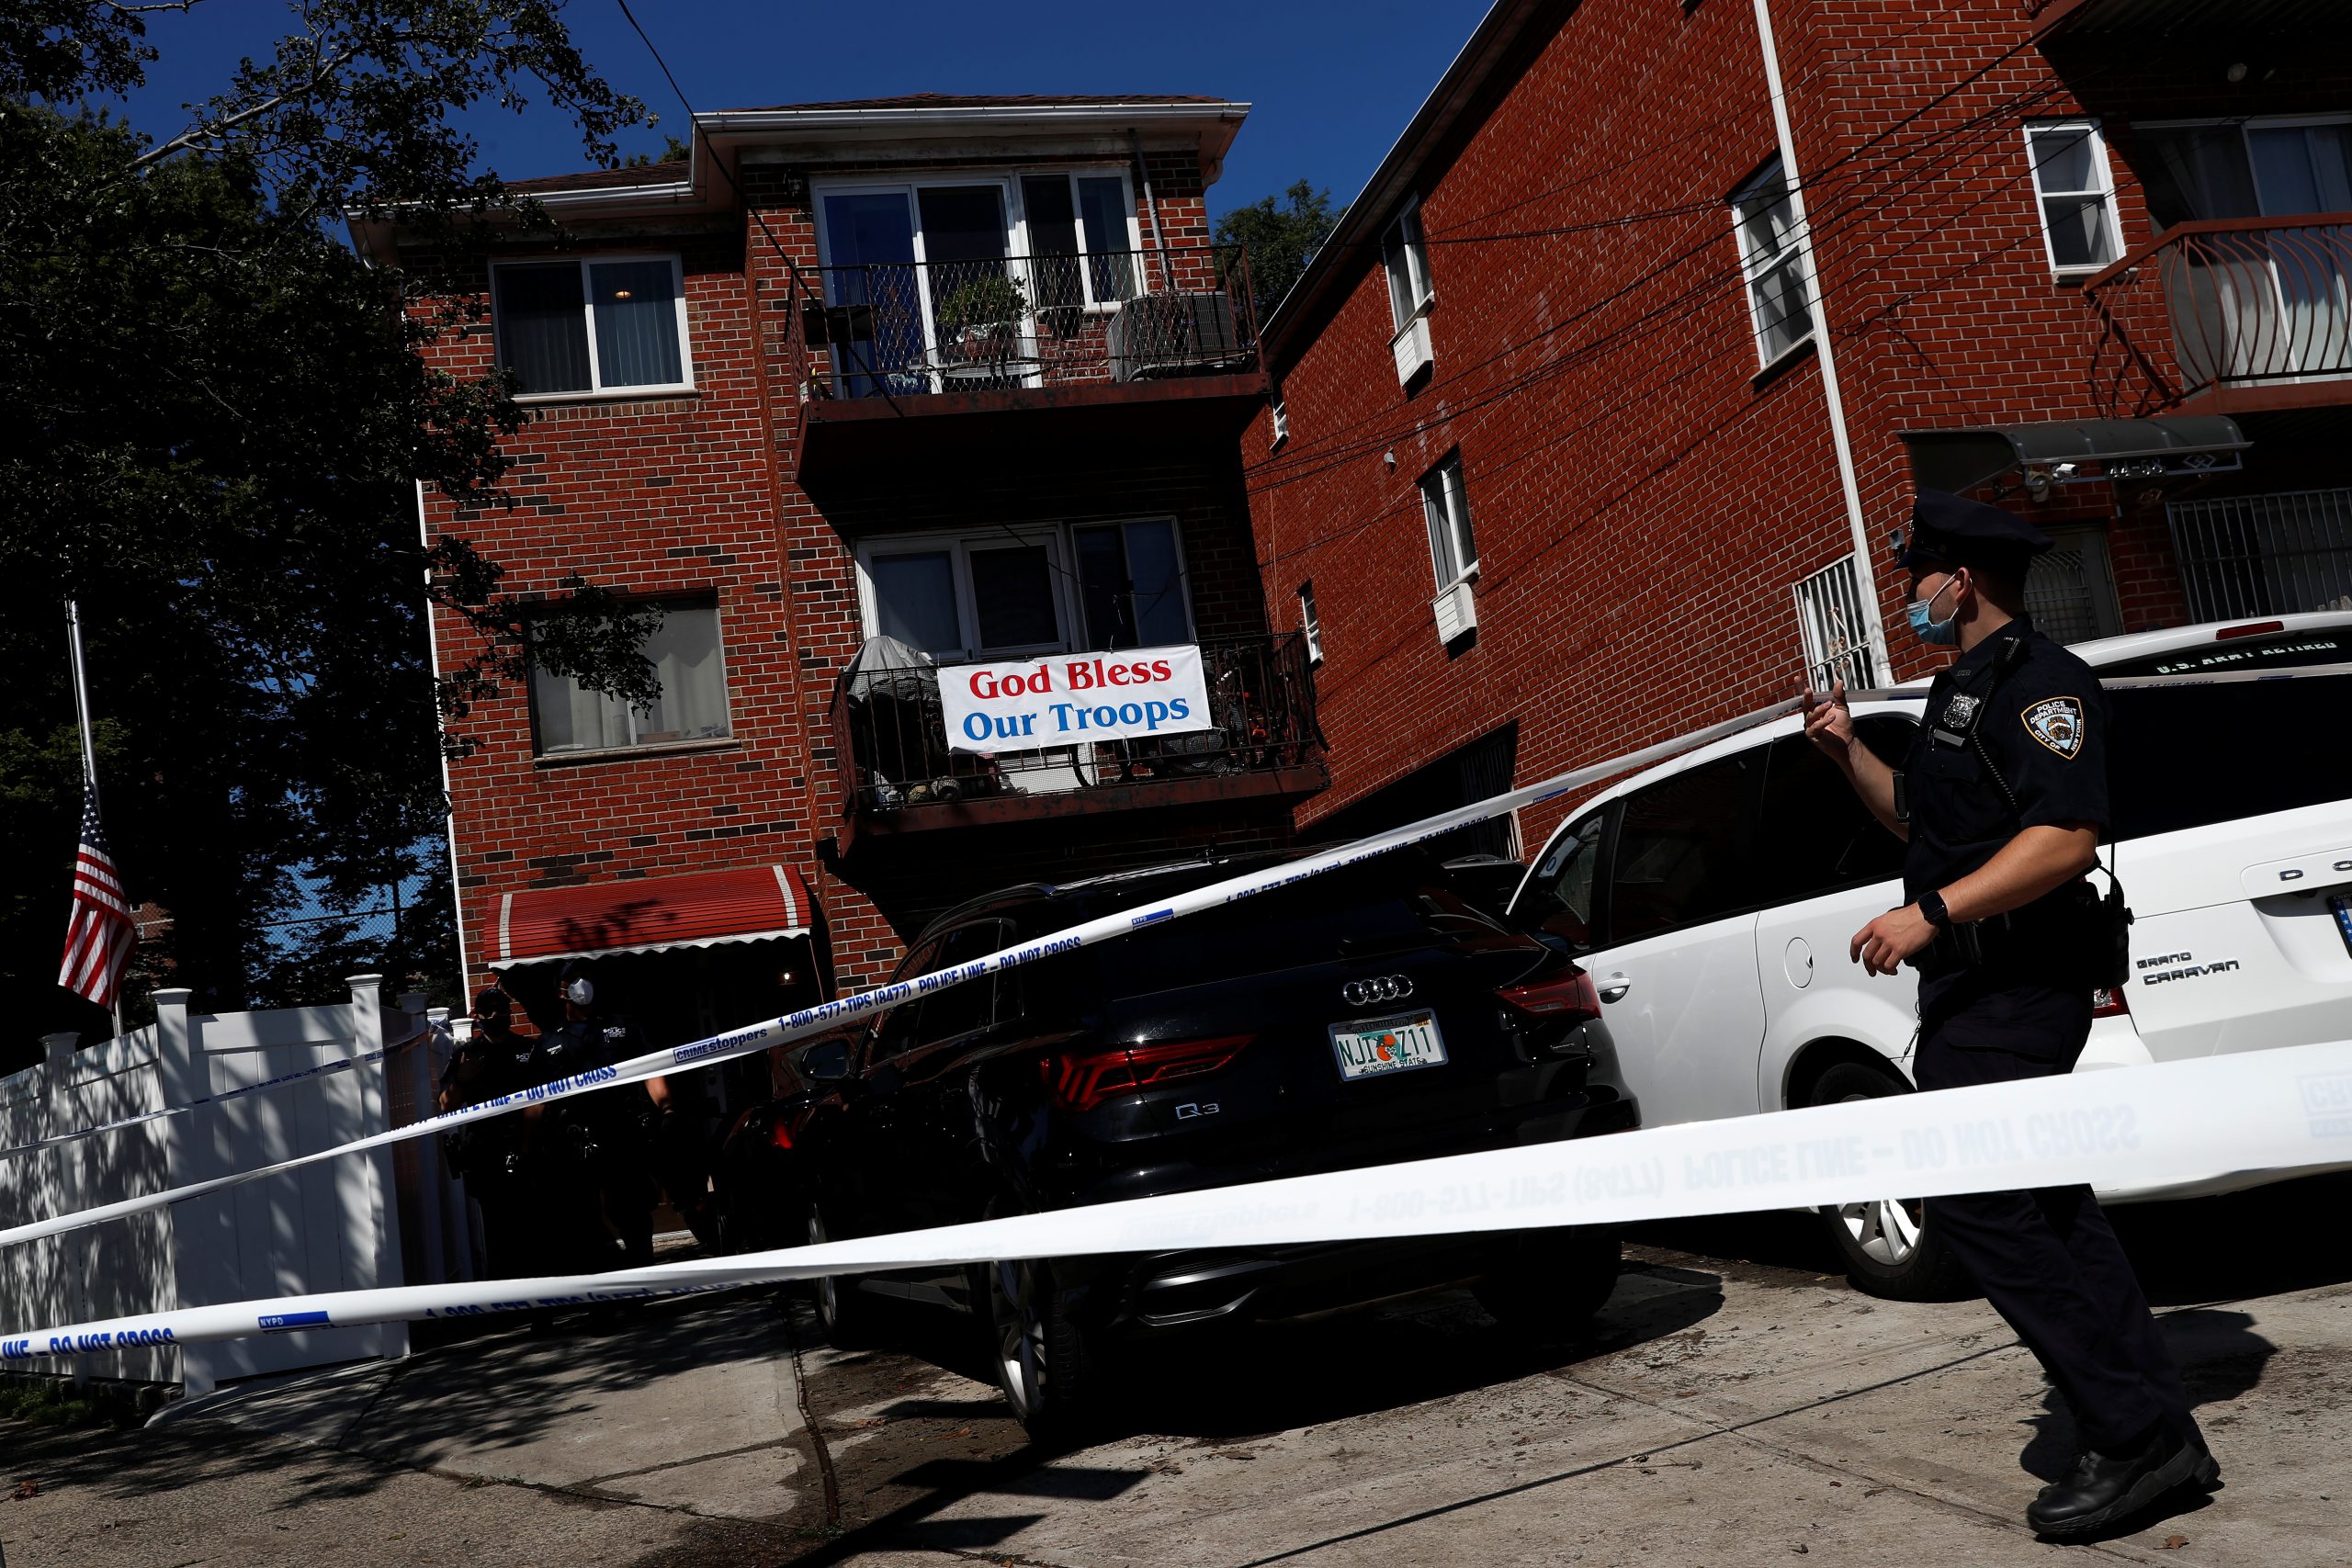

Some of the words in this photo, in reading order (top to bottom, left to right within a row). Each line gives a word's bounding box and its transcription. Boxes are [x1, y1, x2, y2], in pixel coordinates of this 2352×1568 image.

[2202, 649, 2255, 665] ARMY
[2257, 639, 2338, 656] RETIRED
[969, 664, 1052, 699] God
[1066, 659, 1171, 691] Bless
[2030, 706, 2077, 725] DEPARTMENT
[2036, 700, 2066, 714] POLICE
[963, 712, 1036, 740] Our
[1048, 697, 1190, 732] Troops
[2034, 729, 2051, 743] CITY
[2049, 741, 2062, 750] OF
[2070, 737, 2079, 751] NEW
[2136, 952, 2192, 969] GRAND
[2143, 960, 2240, 986] CARAVAN
[778, 994, 872, 1032] 1-800-577-TIPS
[874, 982, 911, 1007] (8477)
[918, 969, 959, 994] POLICE
[1000, 953, 1017, 969] DO
[1018, 946, 1041, 964] NOT
[1044, 935, 1082, 956] CROSS
[1363, 1061, 1396, 1074] SUNSHINE
[1399, 1056, 1421, 1068] STATE
[1175, 1102, 1220, 1120] Q3
[260, 1317, 284, 1326] NYPD
